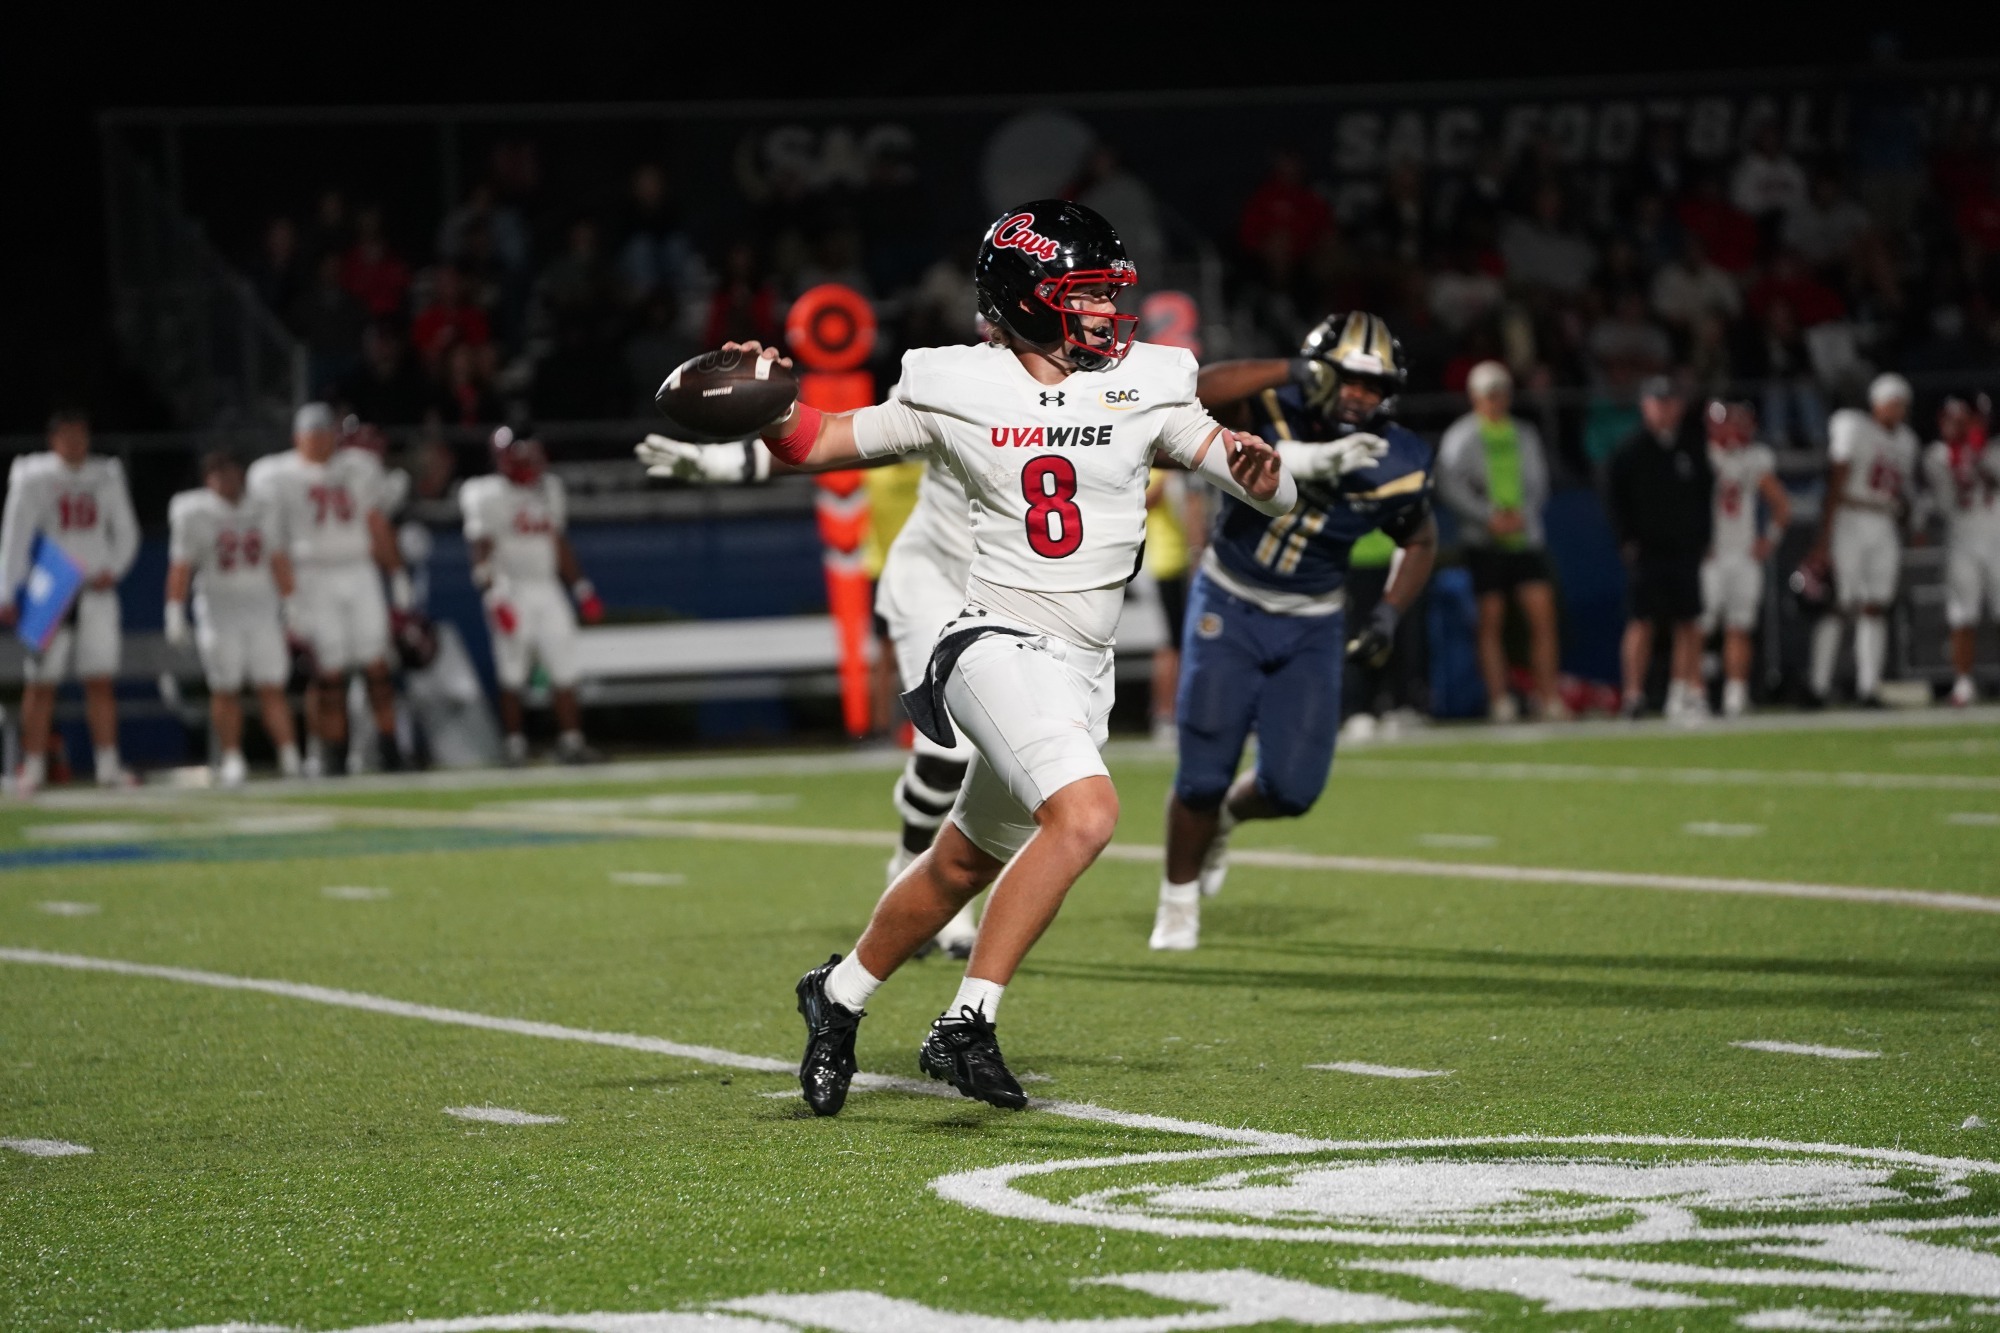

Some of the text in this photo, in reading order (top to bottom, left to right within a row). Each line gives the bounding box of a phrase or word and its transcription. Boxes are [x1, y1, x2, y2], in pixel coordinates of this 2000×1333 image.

[993, 213, 1059, 262] Cavs
[1105, 389, 1139, 403] SAC
[991, 425, 1113, 447] UVAWISE
[1021, 454, 1083, 559] 8
